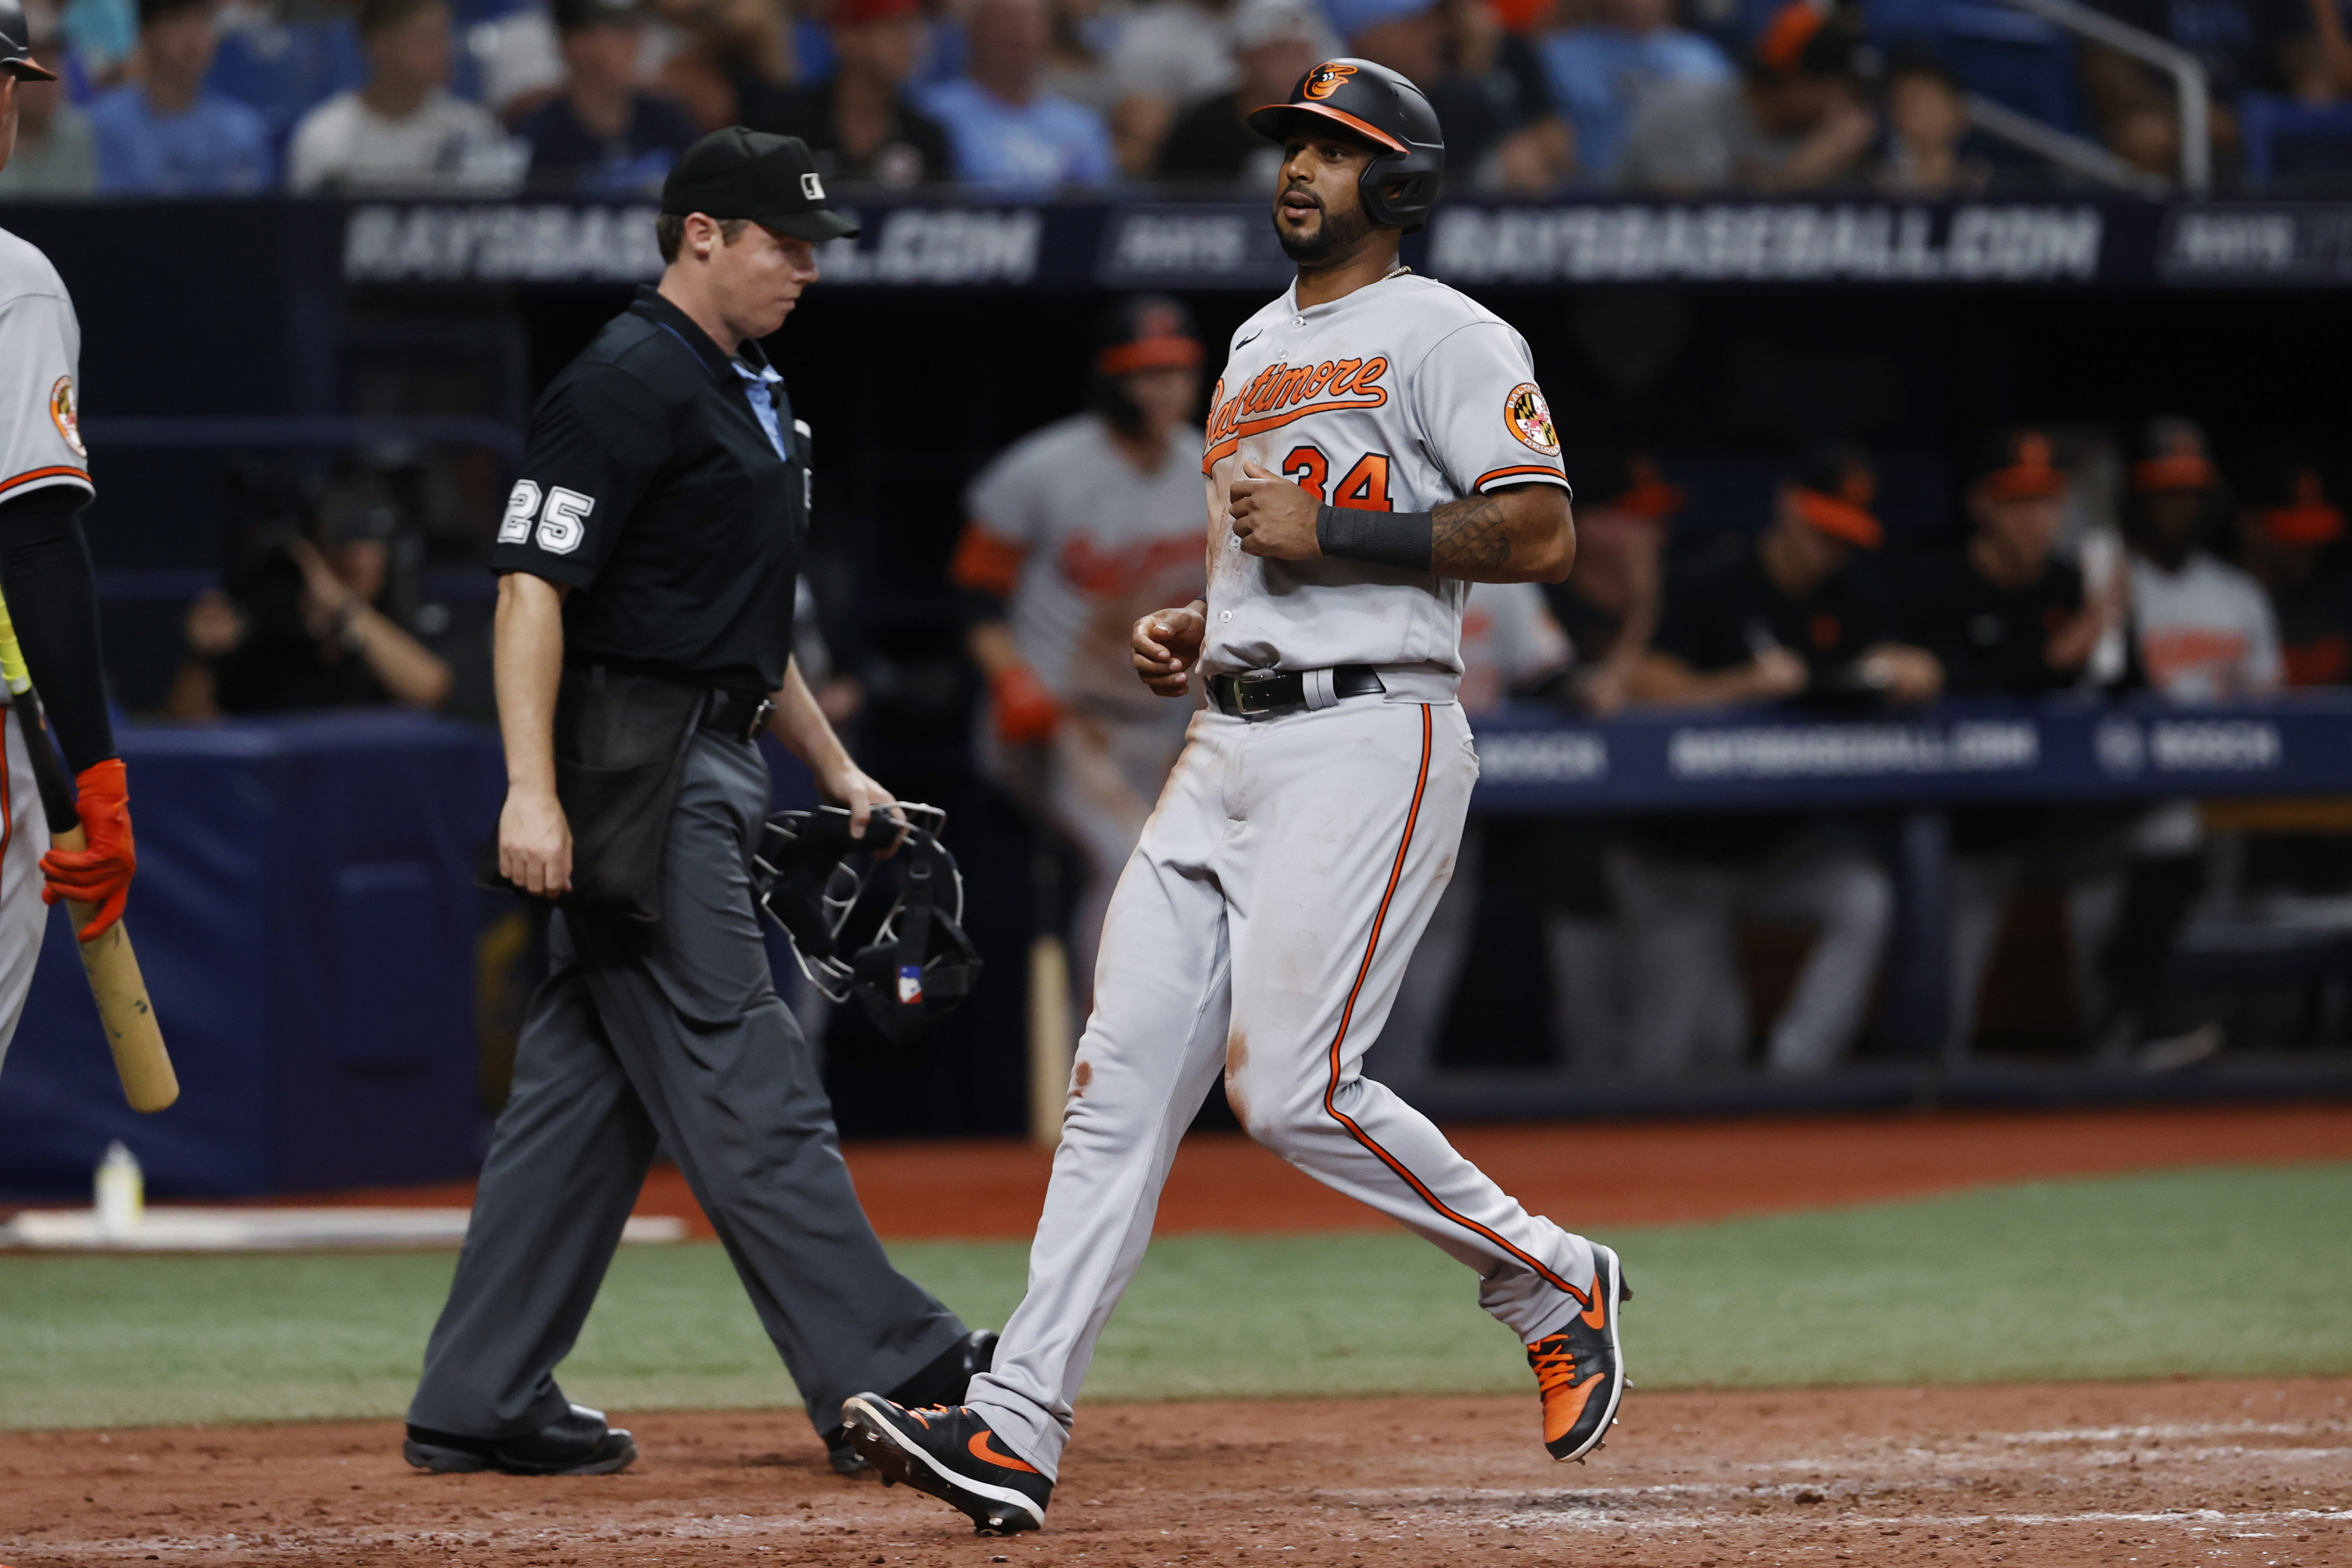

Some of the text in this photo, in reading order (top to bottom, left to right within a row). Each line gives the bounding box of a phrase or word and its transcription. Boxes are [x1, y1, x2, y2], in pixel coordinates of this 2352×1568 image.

[1433, 205, 2101, 281] RAYSBASEBALL.COM
[497, 478, 595, 555] 25
[1283, 446, 1393, 512] 34
